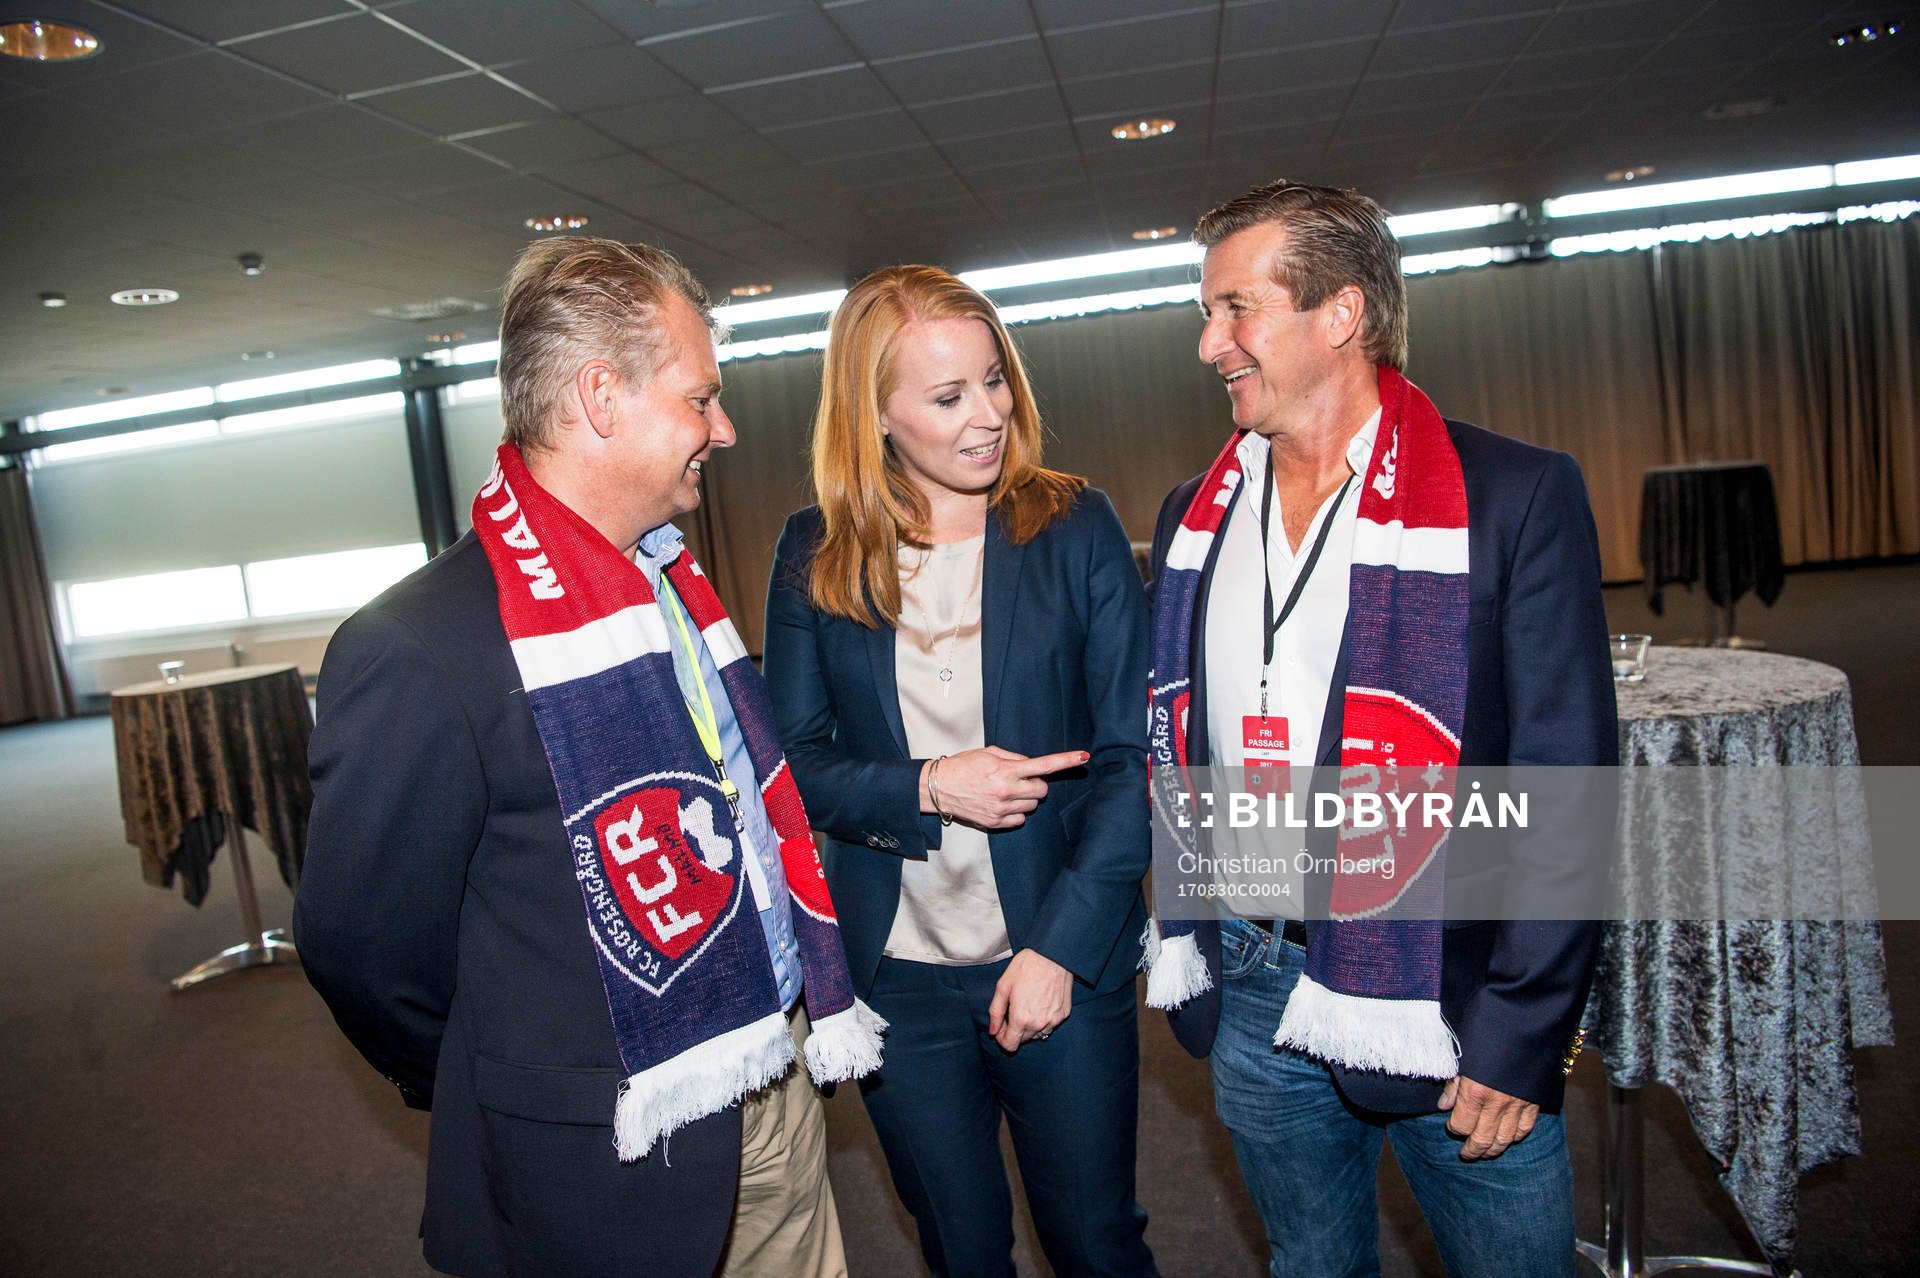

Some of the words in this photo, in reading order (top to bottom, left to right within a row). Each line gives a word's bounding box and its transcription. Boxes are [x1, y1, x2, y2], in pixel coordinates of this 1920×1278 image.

[1259, 729, 1273, 738] FRI
[1248, 738, 1285, 749] PASSAGE
[604, 804, 703, 943] FCR
